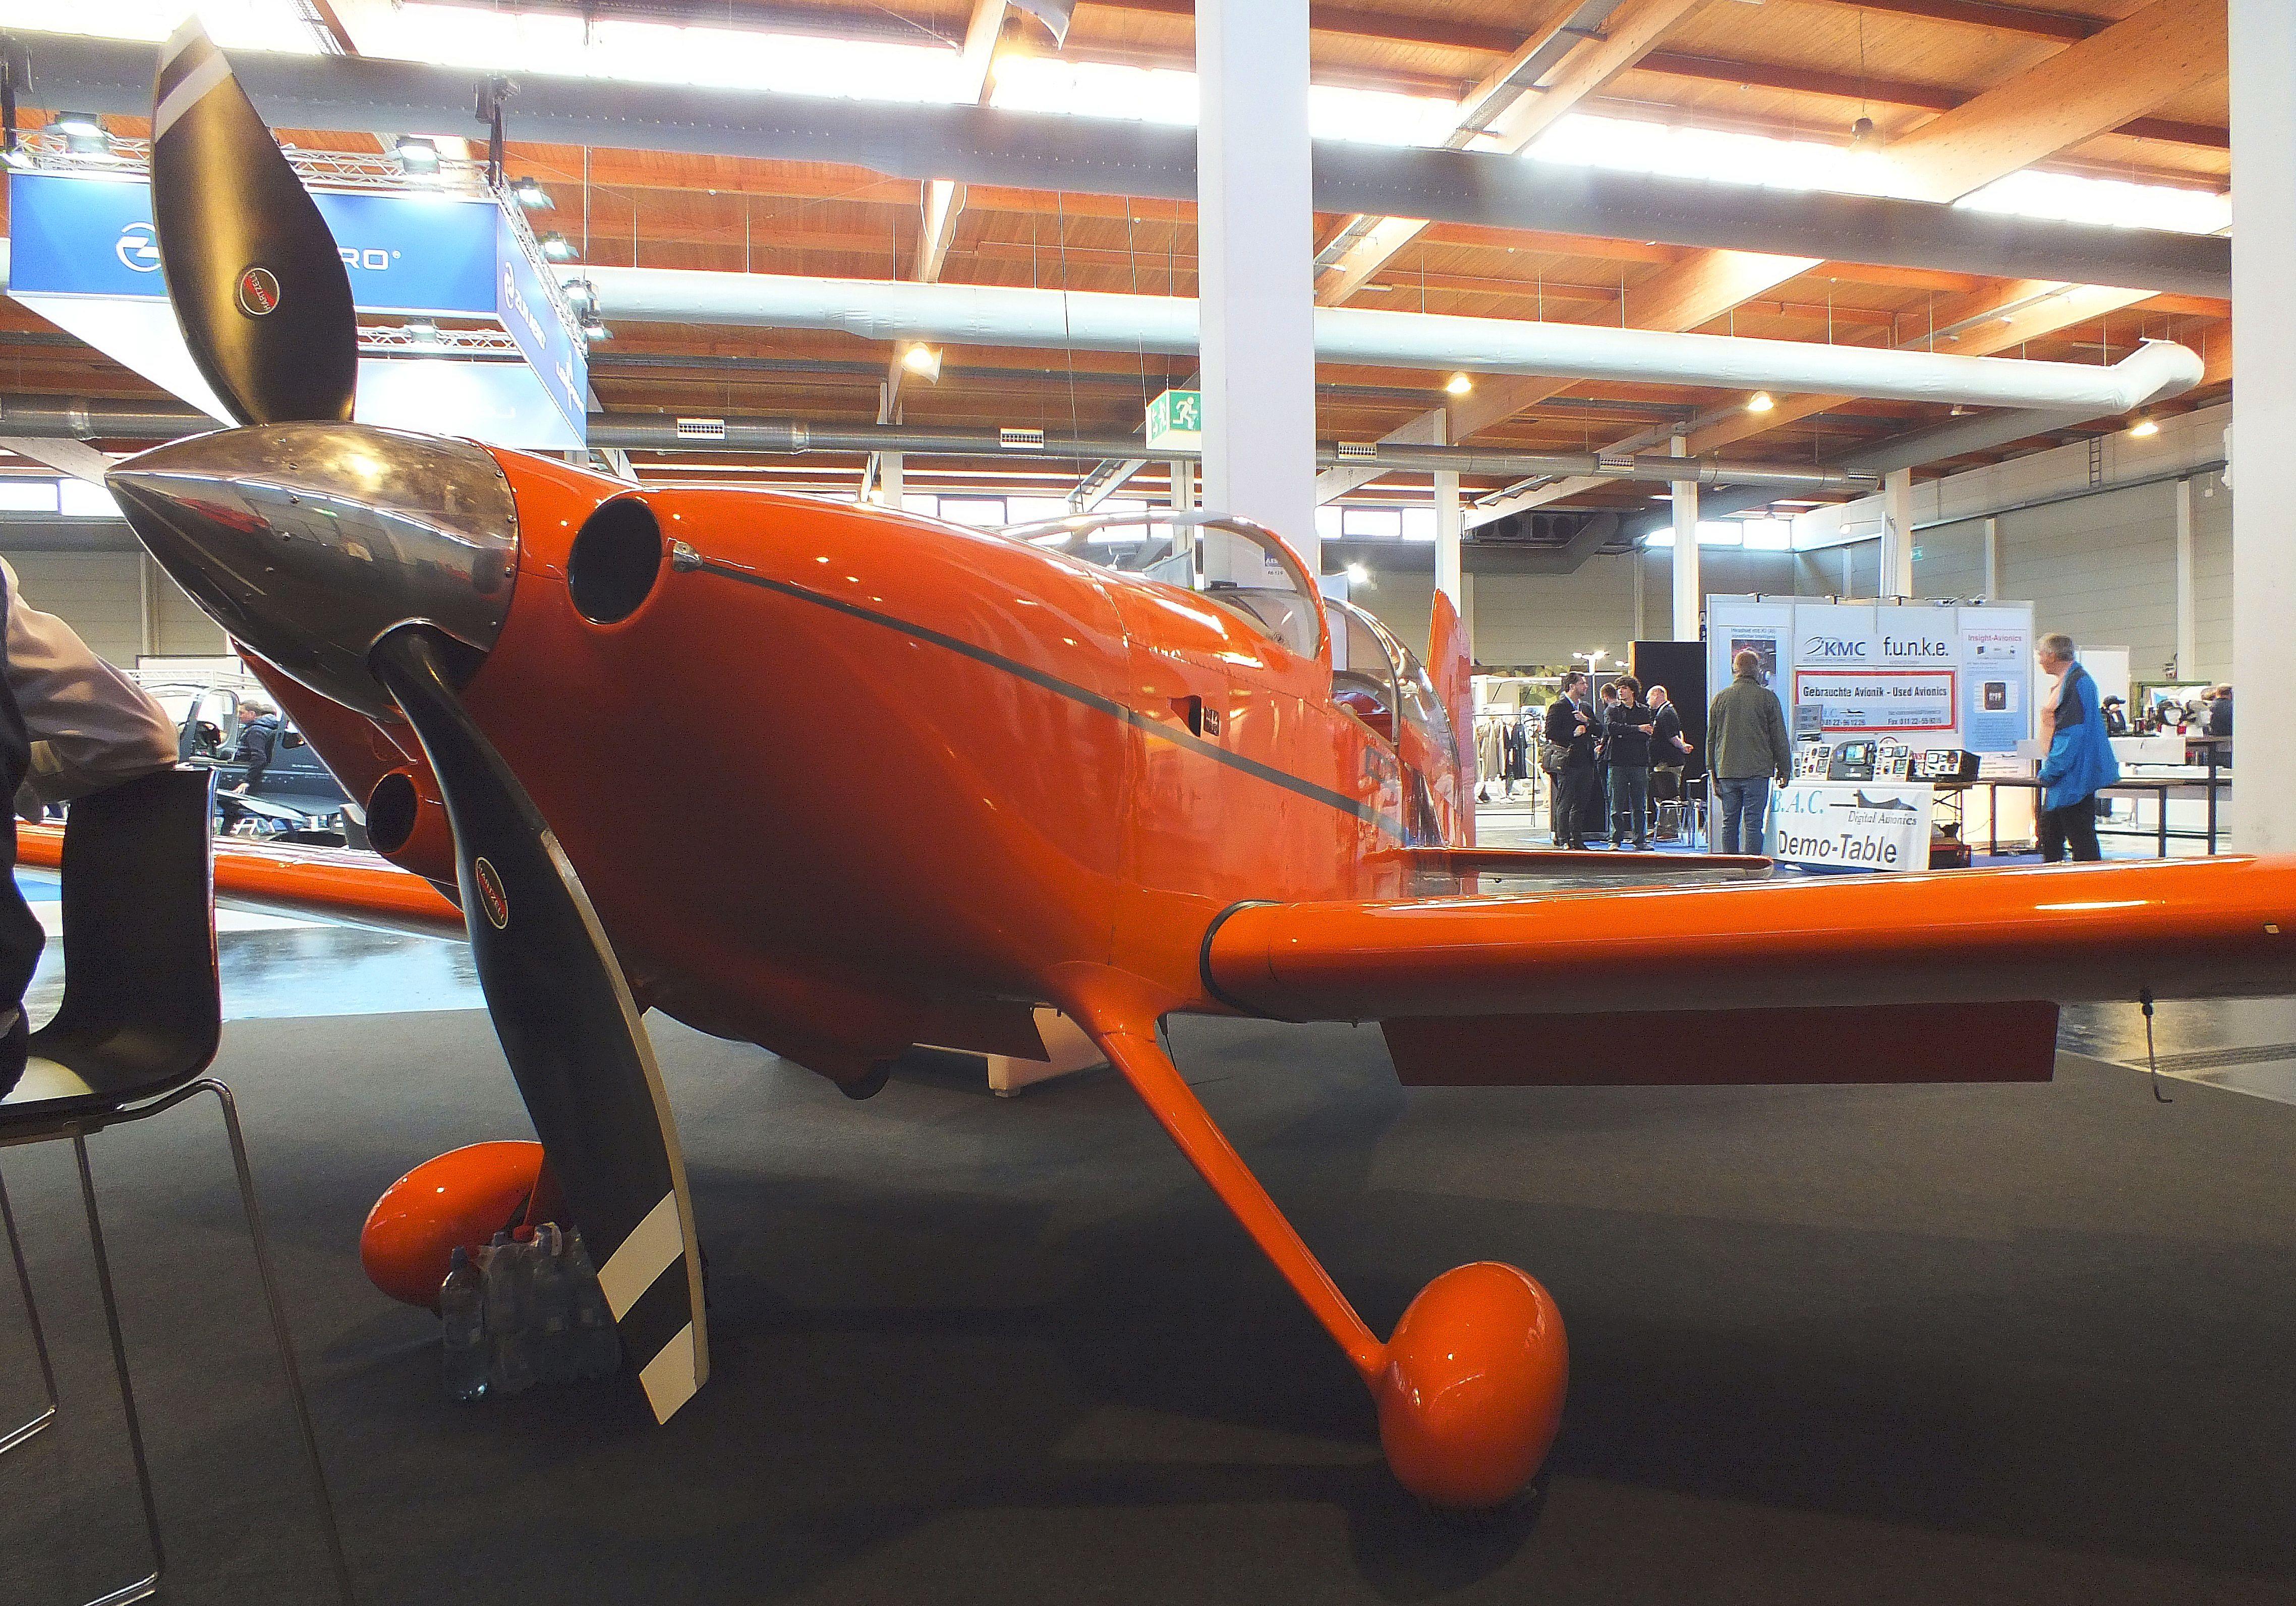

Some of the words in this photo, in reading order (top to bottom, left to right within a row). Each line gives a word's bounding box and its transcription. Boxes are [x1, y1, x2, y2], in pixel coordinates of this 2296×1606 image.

[251, 272, 271, 311] HARTZELL
[1883, 636, 1948, 656] f.u.n.k.e.
[1968, 635, 2022, 643] Insight-Avionics
[1824, 641, 1866, 656] KMC
[1803, 686, 1851, 697] Gebrauchte
[1855, 686, 1883, 697] Avionik
[1892, 686, 1911, 696] Used
[1914, 686, 1947, 696] Avionics
[1771, 790, 1824, 814] B.A.C.
[1848, 811, 1877, 825] Digital
[1878, 813, 1917, 826] Avionics
[1778, 830, 1897, 864] Demo-Table
